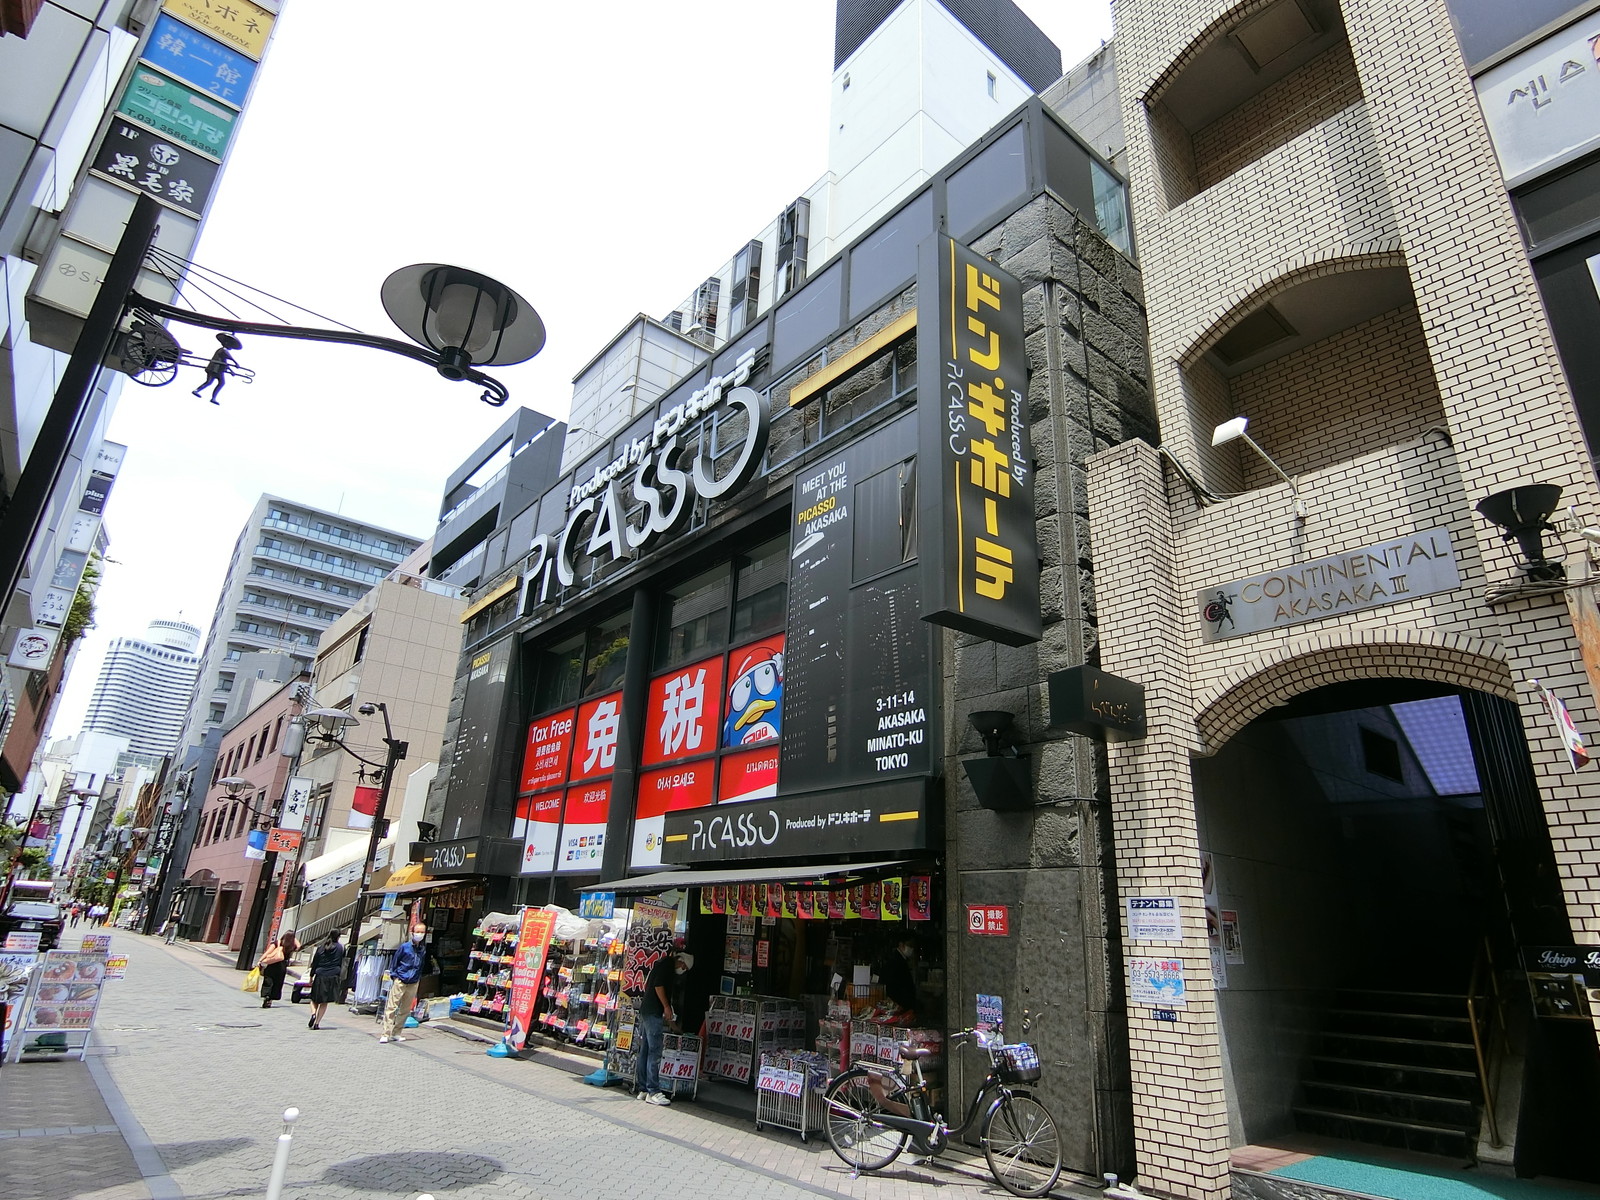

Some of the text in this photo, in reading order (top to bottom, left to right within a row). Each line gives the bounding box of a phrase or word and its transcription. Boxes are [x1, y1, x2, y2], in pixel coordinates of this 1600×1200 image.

[156, 33, 242, 85] 韓一館
[120, 126, 140, 140] 1F
[108, 152, 195, 204] 黒毛家
[1009, 388, 1026, 488] Produced by
[569, 444, 630, 508] Produced
[630, 436, 651, 466] by
[802, 461, 847, 495] MEET YOU
[85, 488, 105, 499] plus
[816, 476, 848, 502] AT THE
[798, 496, 836, 526] PICASSO
[804, 506, 848, 537] AKASAKA
[1240, 536, 1449, 604] CONTINENTAL
[1273, 580, 1388, 623] AKASAKA
[876, 690, 916, 712] 3-11-14
[531, 718, 572, 744] Tax Free
[583, 668, 707, 774] 免 税
[878, 708, 926, 732] AKASAKA
[867, 729, 924, 754] MINATO-KU
[875, 752, 910, 772] TOKYO
[657, 771, 696, 791] 어서 오세요
[535, 798, 560, 812] WELCOME
[583, 788, 606, 804] 欢迎光临
[786, 814, 816, 830] Produced
[816, 816, 827, 830] by
[568, 838, 578, 847] VISA
[987, 910, 1004, 920] 撮影
[987, 920, 1004, 931] 禁止
[1130, 960, 1180, 971] テナント募集
[1538, 950, 1577, 968] Ichigo
[1132, 970, 1180, 980] 03-5573-8666
